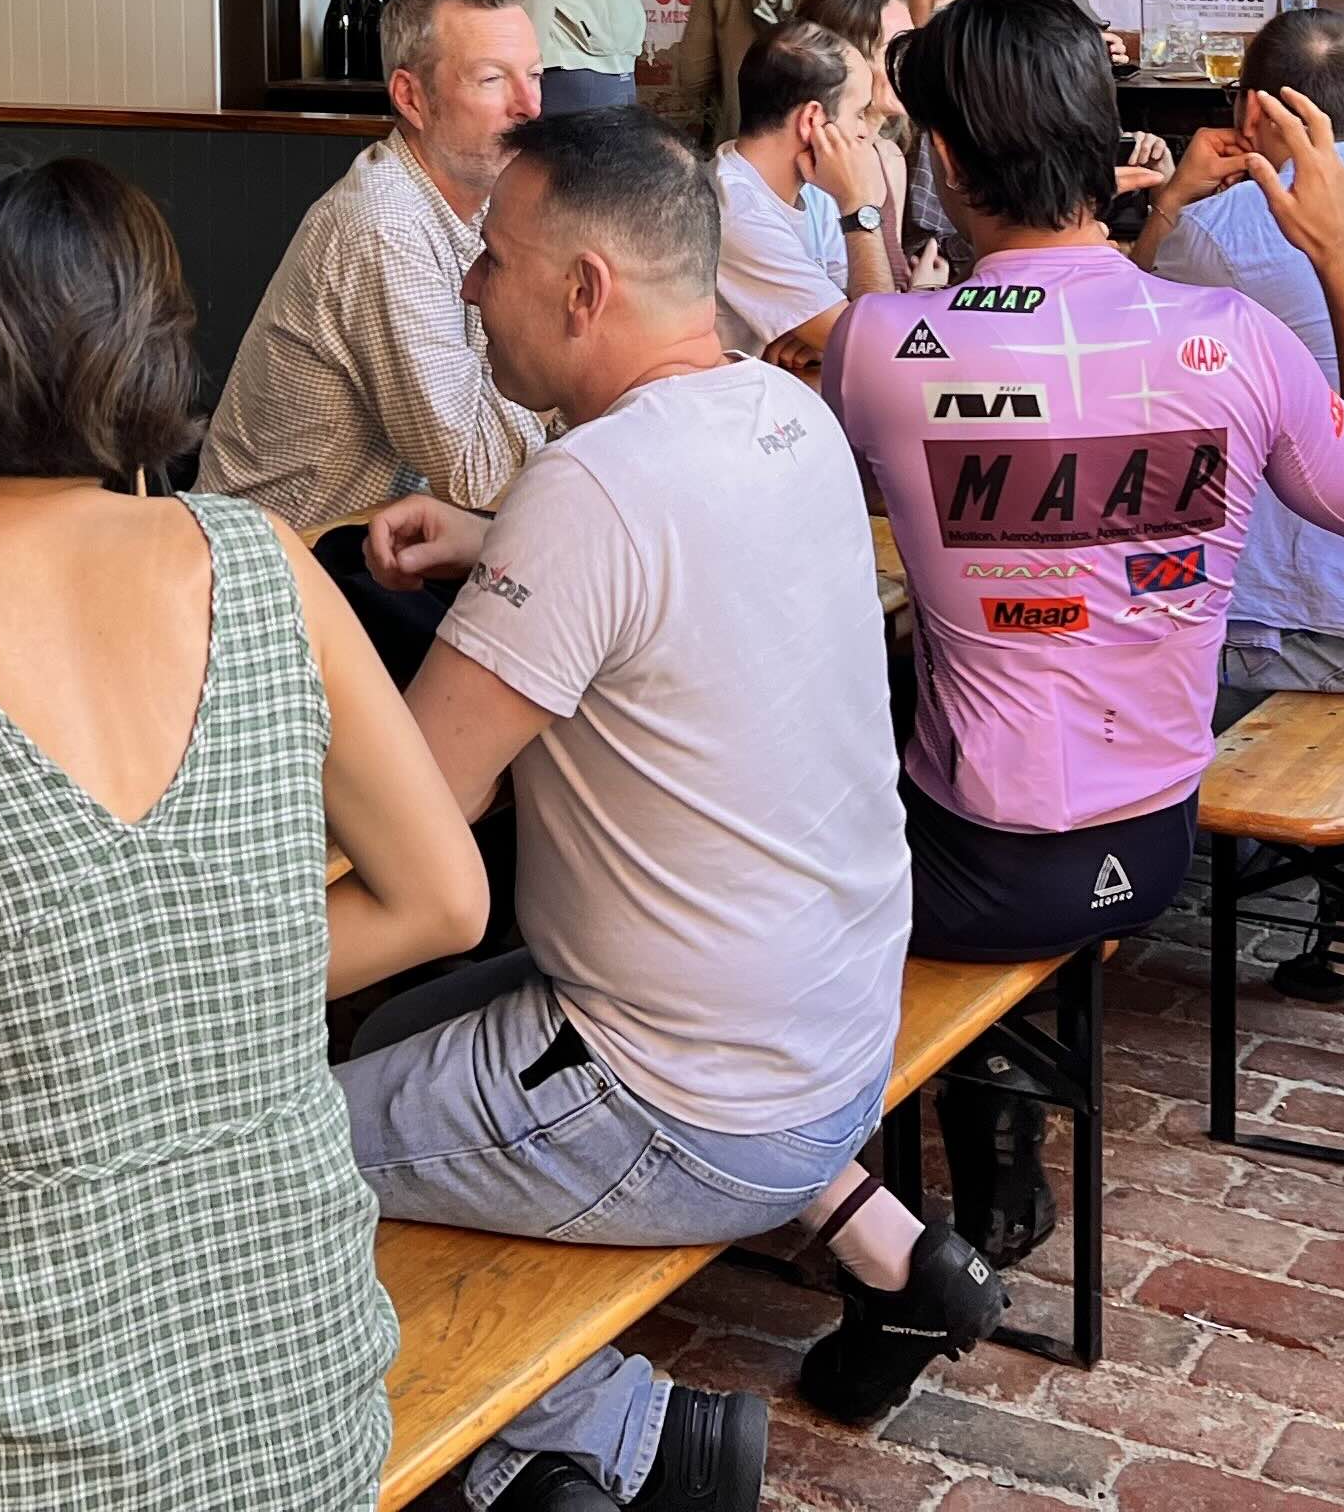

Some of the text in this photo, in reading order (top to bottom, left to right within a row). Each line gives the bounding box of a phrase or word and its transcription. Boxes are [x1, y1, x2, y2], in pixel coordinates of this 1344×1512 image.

[955, 288, 1042, 310] MAAP
[914, 328, 929, 341] M
[948, 444, 1221, 522] MAAP
[993, 602, 1081, 629] Maap
[1090, 891, 1134, 910] NEOPRO
